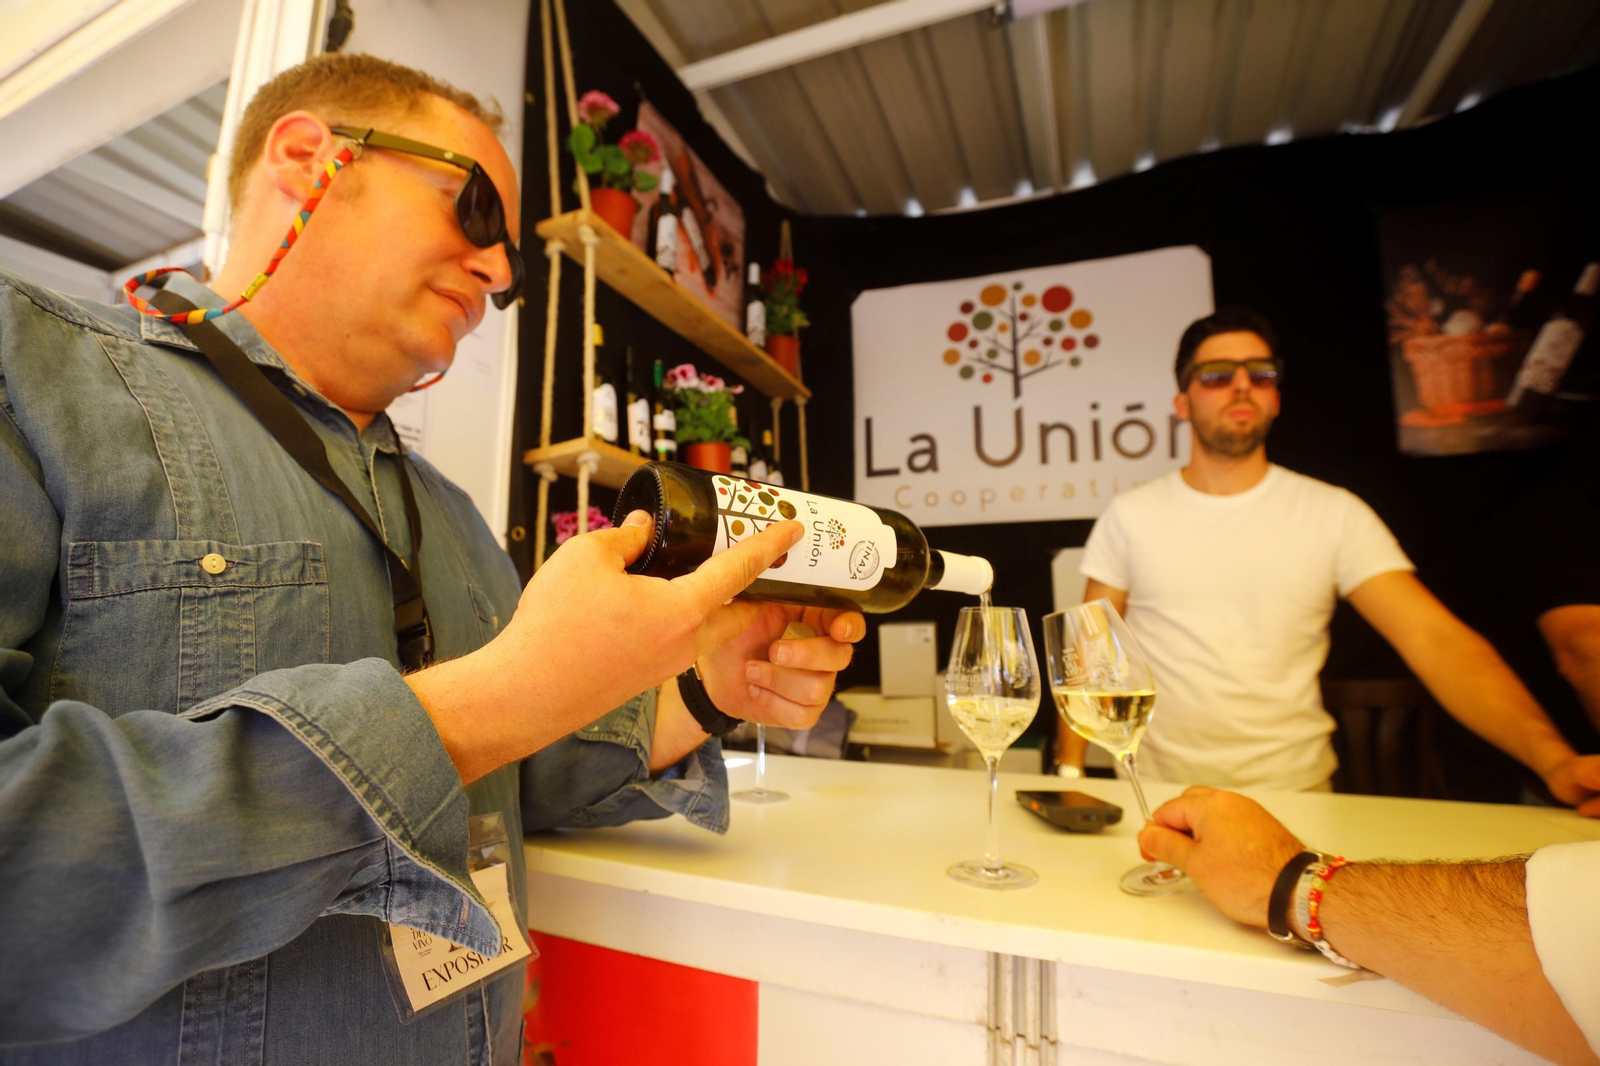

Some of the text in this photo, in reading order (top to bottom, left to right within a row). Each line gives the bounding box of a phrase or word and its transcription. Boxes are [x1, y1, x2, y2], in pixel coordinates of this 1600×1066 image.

[865, 416, 939, 478] La
[806, 500, 818, 514] La
[893, 476, 1150, 512] Cooperati
[850, 540, 875, 579] TINAJA
[421, 936, 513, 992] EXPOSIR
